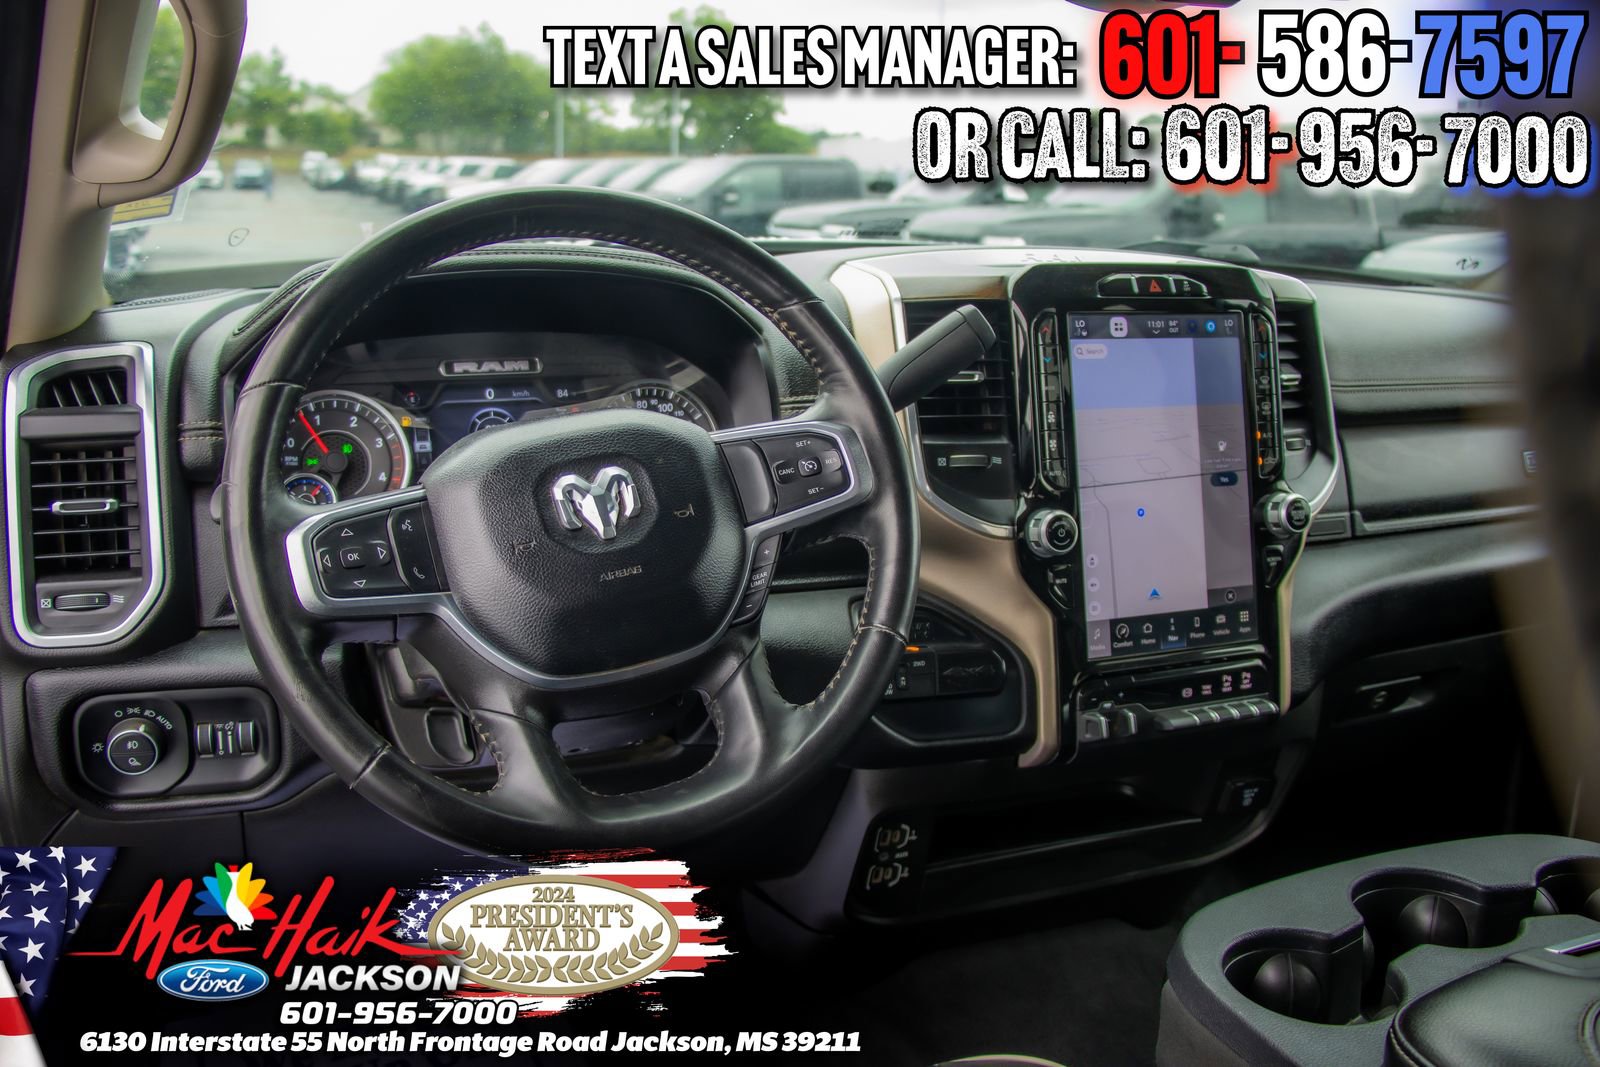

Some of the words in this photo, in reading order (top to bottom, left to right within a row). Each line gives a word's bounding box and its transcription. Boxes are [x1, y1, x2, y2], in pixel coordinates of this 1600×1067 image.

[453, 360, 530, 373] RAM
[485, 388, 495, 400] 0
[636, 400, 648, 409] 80
[657, 402, 673, 412] 100
[314, 415, 321, 426] 1
[350, 416, 358, 427] 2
[287, 438, 295, 448] 0
[376, 438, 383, 448] 3
[379, 471, 388, 481] 4
[779, 467, 795, 476] CANC
[347, 552, 360, 561] OK
[752, 571, 768, 581] GEAR
[750, 578, 766, 587] LIMIT
[156, 715, 173, 730] AUTO
